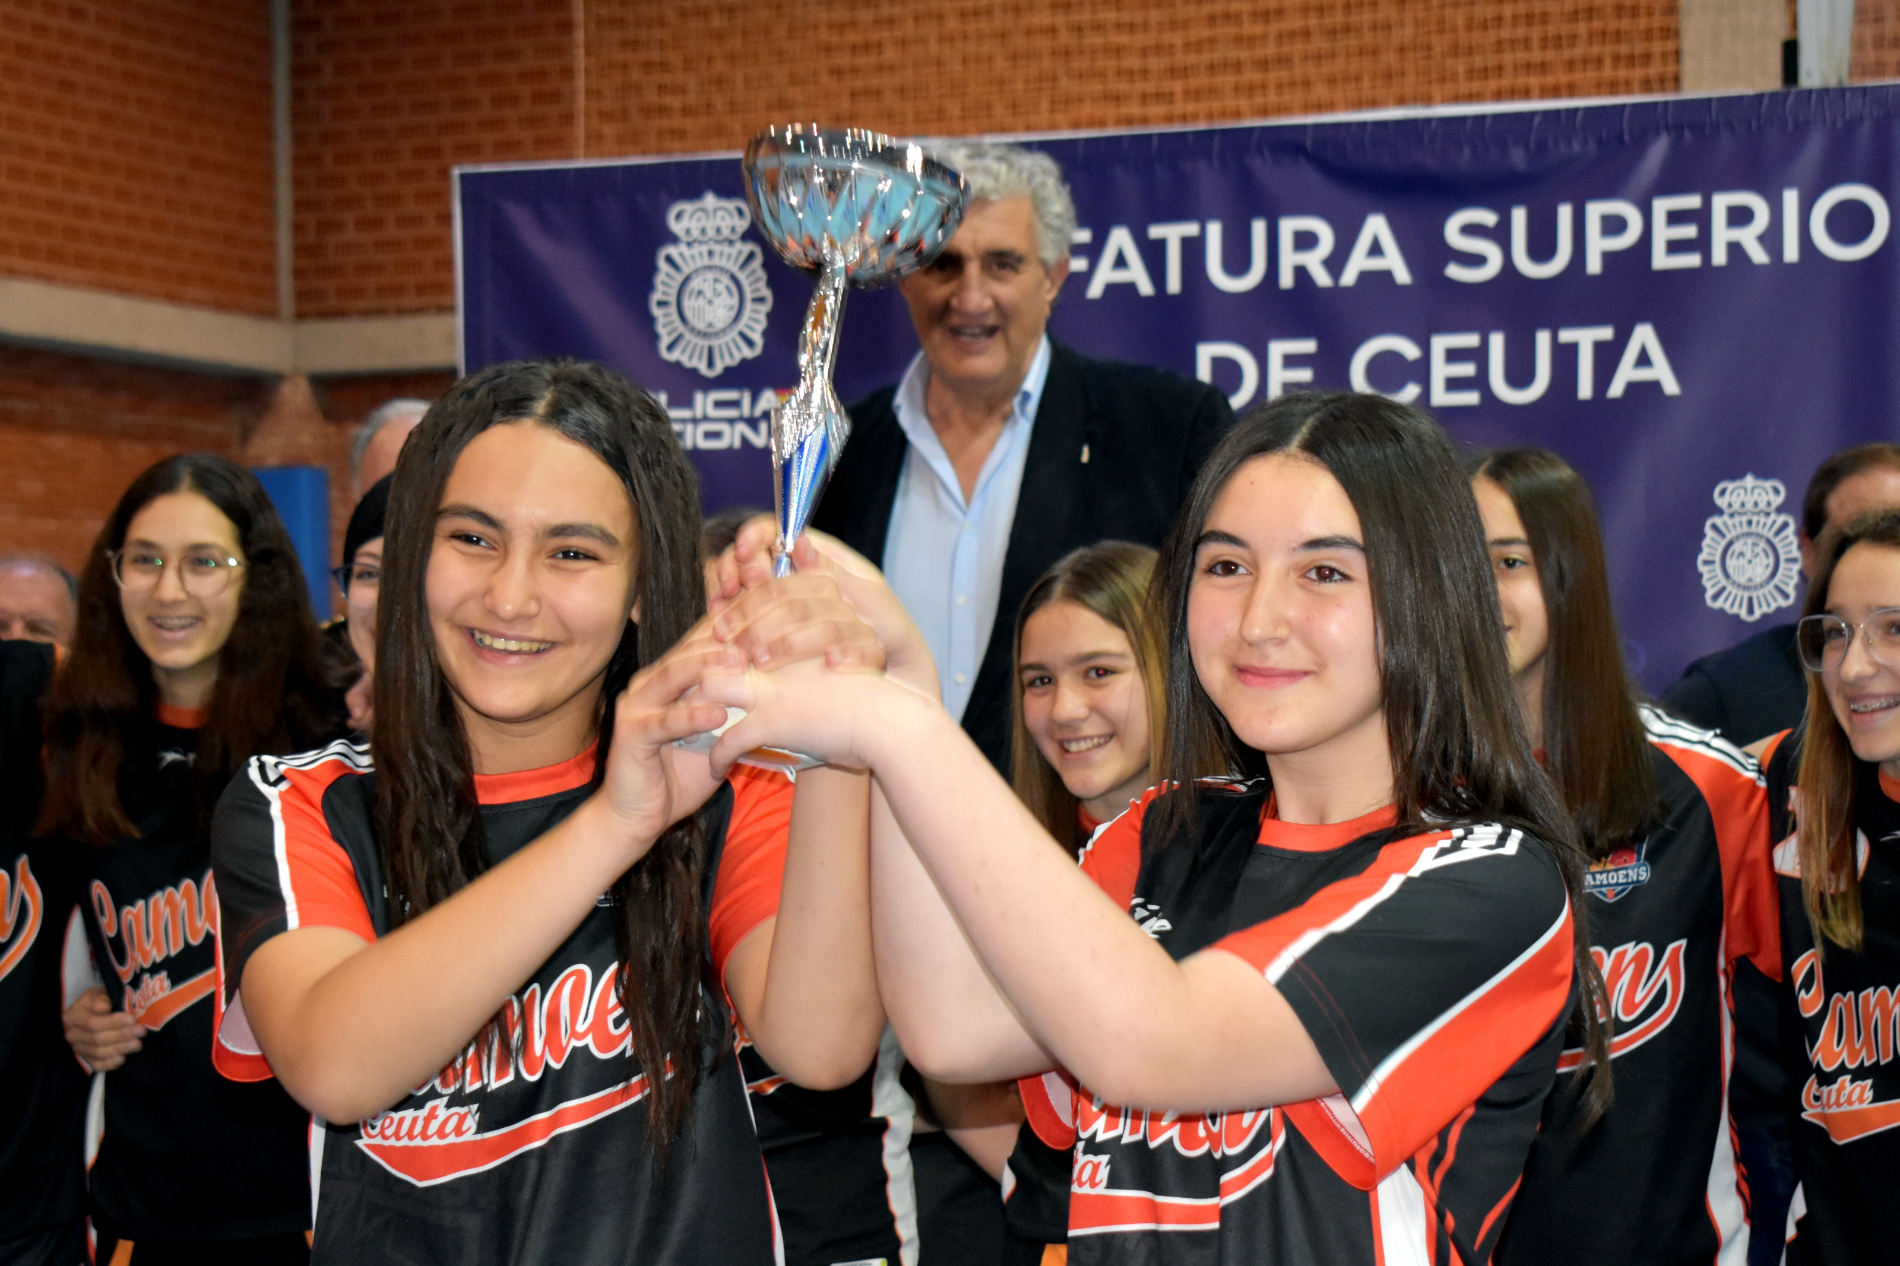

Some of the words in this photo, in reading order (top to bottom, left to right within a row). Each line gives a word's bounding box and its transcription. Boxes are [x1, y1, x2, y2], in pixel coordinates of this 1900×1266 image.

[1443, 182, 1891, 283] SUPERIO
[1196, 338, 1318, 412] DE
[1349, 321, 1682, 408] CEUTA
[653, 388, 779, 419] LICIA
[360, 1097, 480, 1145] Ceuta
